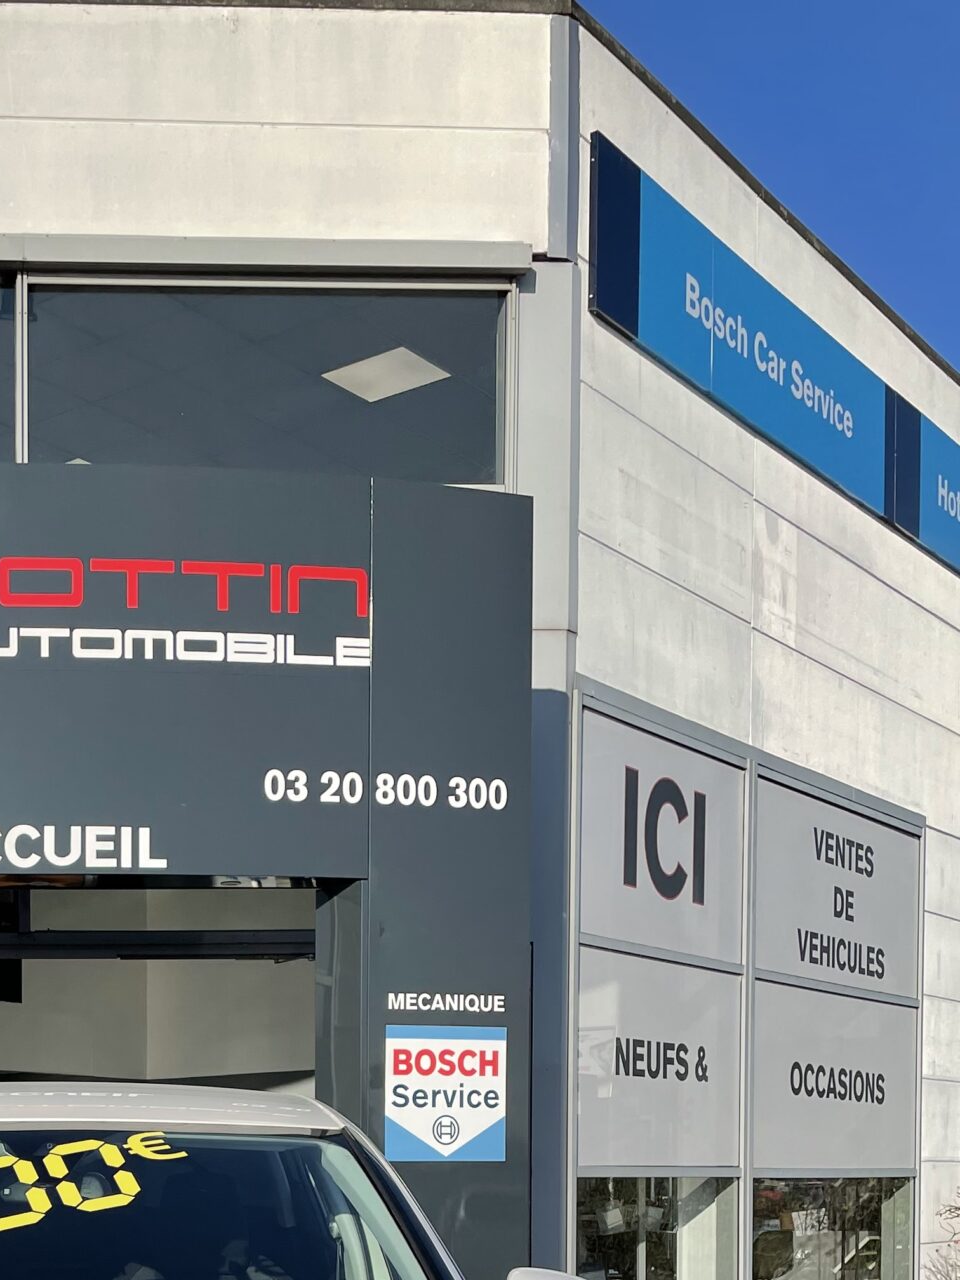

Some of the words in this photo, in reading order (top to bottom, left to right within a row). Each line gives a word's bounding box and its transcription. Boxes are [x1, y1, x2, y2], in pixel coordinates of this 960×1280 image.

[685, 272, 748, 359] Bosch
[754, 331, 786, 386] Car
[791, 360, 854, 439] Service
[264, 769, 308, 802] 03
[320, 770, 363, 804] 20
[375, 773, 437, 807] 800
[448, 776, 508, 810] 300
[623, 764, 706, 906] ICI
[814, 827, 874, 878] VENTES
[833, 886, 854, 923] DE
[797, 928, 885, 980] VEHICULES
[387, 993, 506, 1013] MECANIQUE
[393, 1048, 499, 1077] BOSCH
[615, 1036, 690, 1082] NEUFS
[694, 1046, 709, 1082] &
[391, 1083, 500, 1109] Service
[790, 1061, 886, 1105] OCCASIONS
